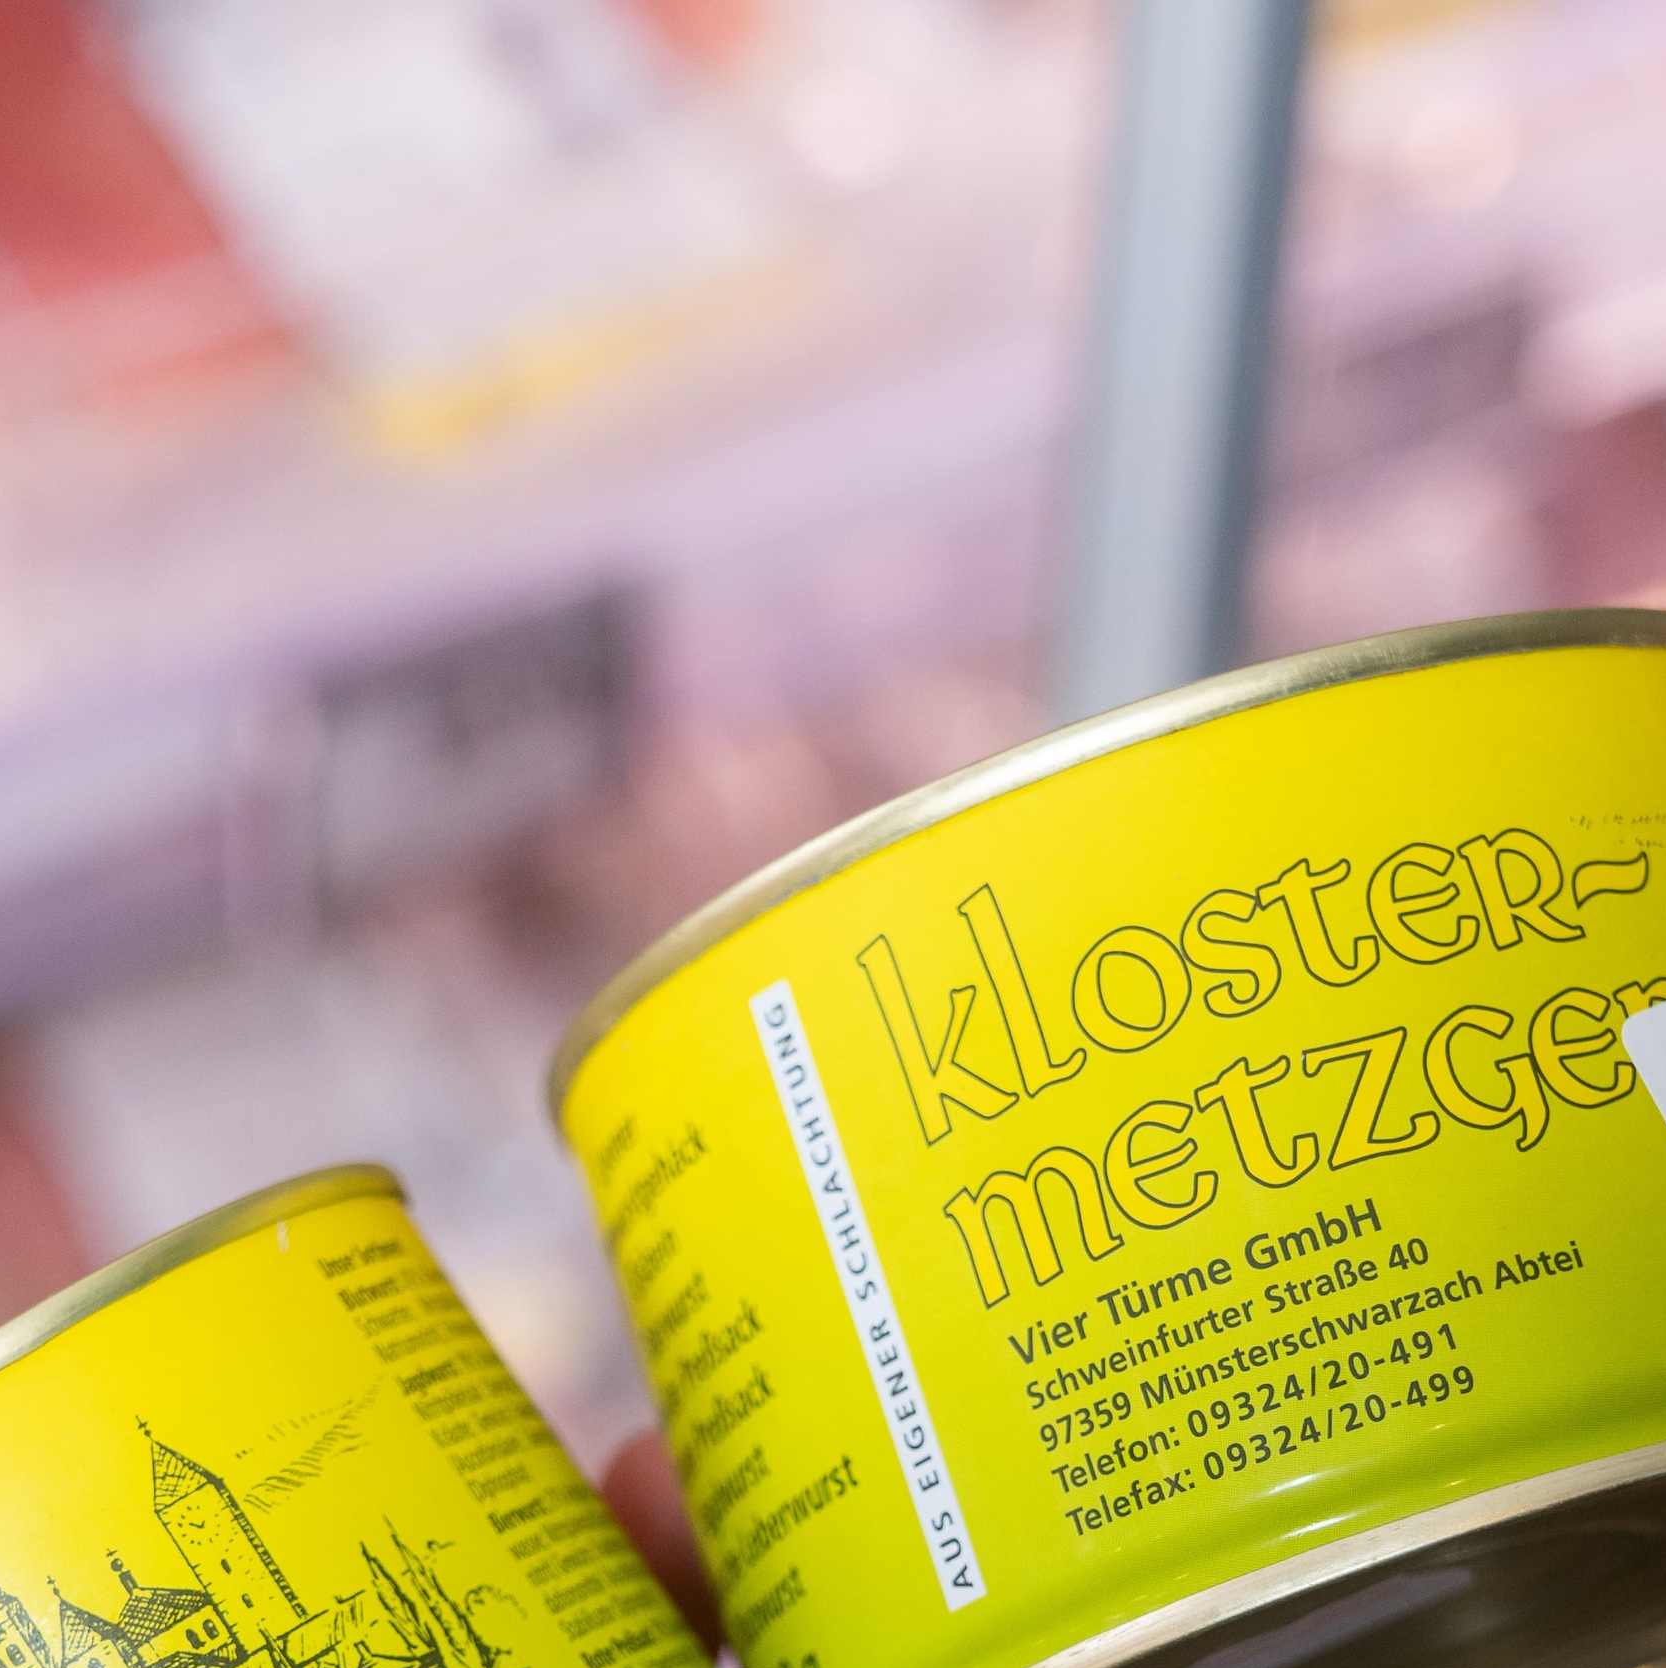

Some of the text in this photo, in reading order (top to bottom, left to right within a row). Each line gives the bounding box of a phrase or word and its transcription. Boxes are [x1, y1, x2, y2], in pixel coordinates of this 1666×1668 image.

[764, 1003, 974, 1589] AUS EIGENER SCHLACHTUNG
[1008, 1198, 1383, 1365] Vier Türme GmbH
[1026, 1237, 1429, 1411] Schweinfurter Straße 40
[1040, 1241, 1585, 1452] 97359 Münsterschwarzach Abtei
[1051, 1322, 1459, 1494] Telefon: 09324/20-491
[1065, 1365, 1475, 1537] Telefax: 09324/20-499
